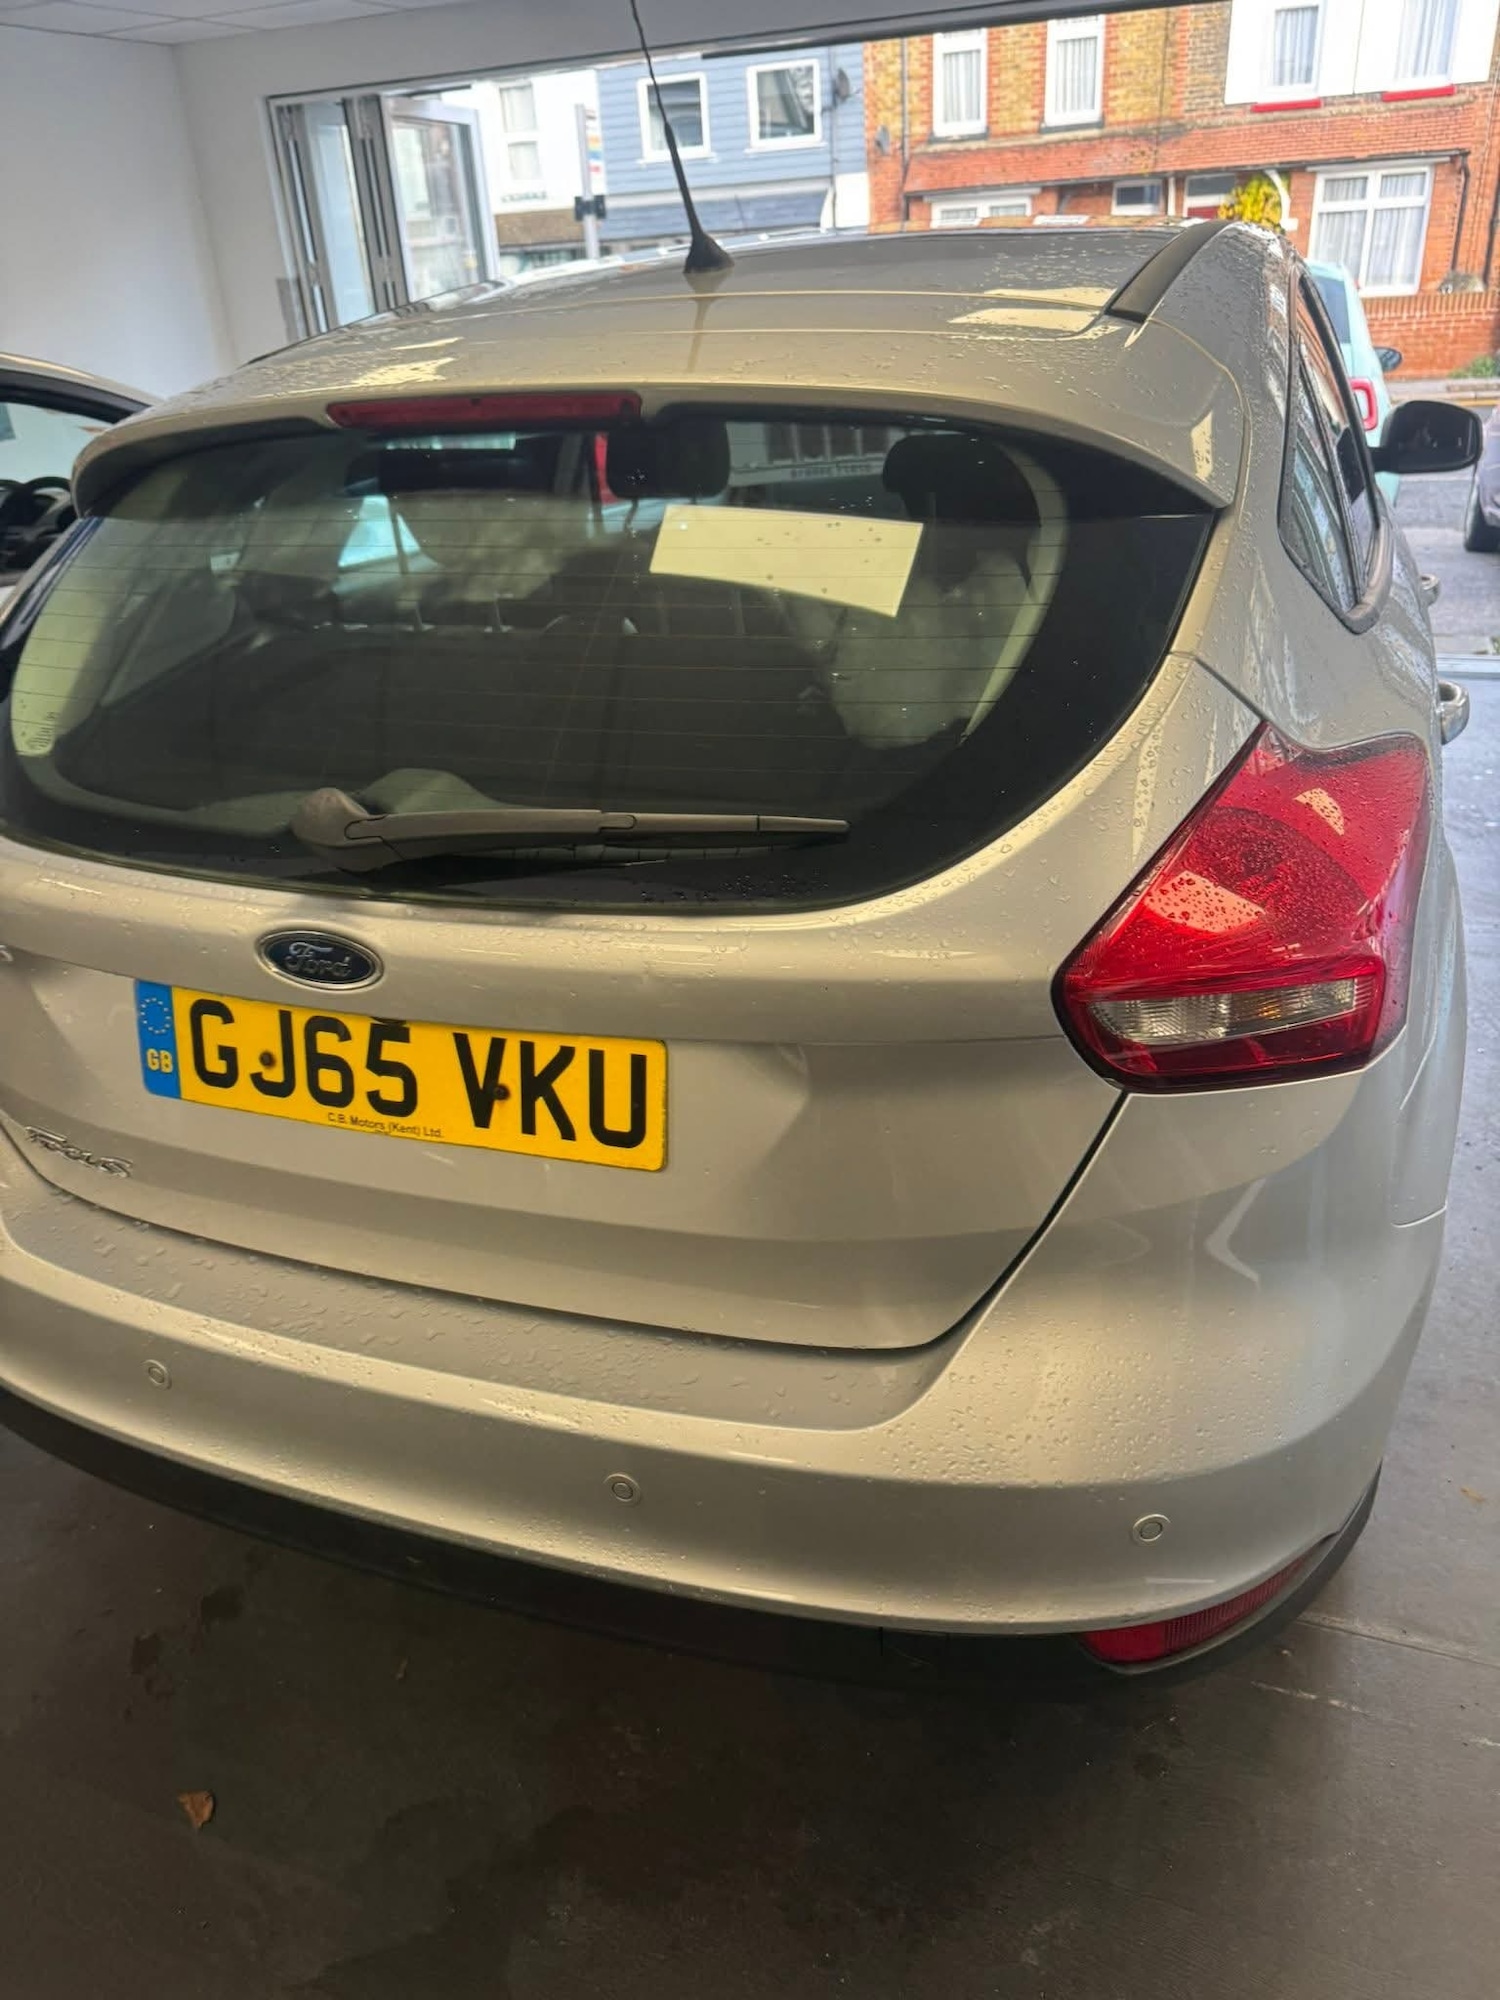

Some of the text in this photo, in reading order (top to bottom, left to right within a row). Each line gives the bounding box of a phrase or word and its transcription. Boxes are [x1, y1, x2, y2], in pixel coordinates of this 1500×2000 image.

[284, 941, 352, 977] Ford
[147, 1049, 173, 1074] GB
[190, 998, 647, 1148] GJ65 VKU
[350, 1115, 386, 1130] Motors
[388, 1122, 420, 1137] (Kent)
